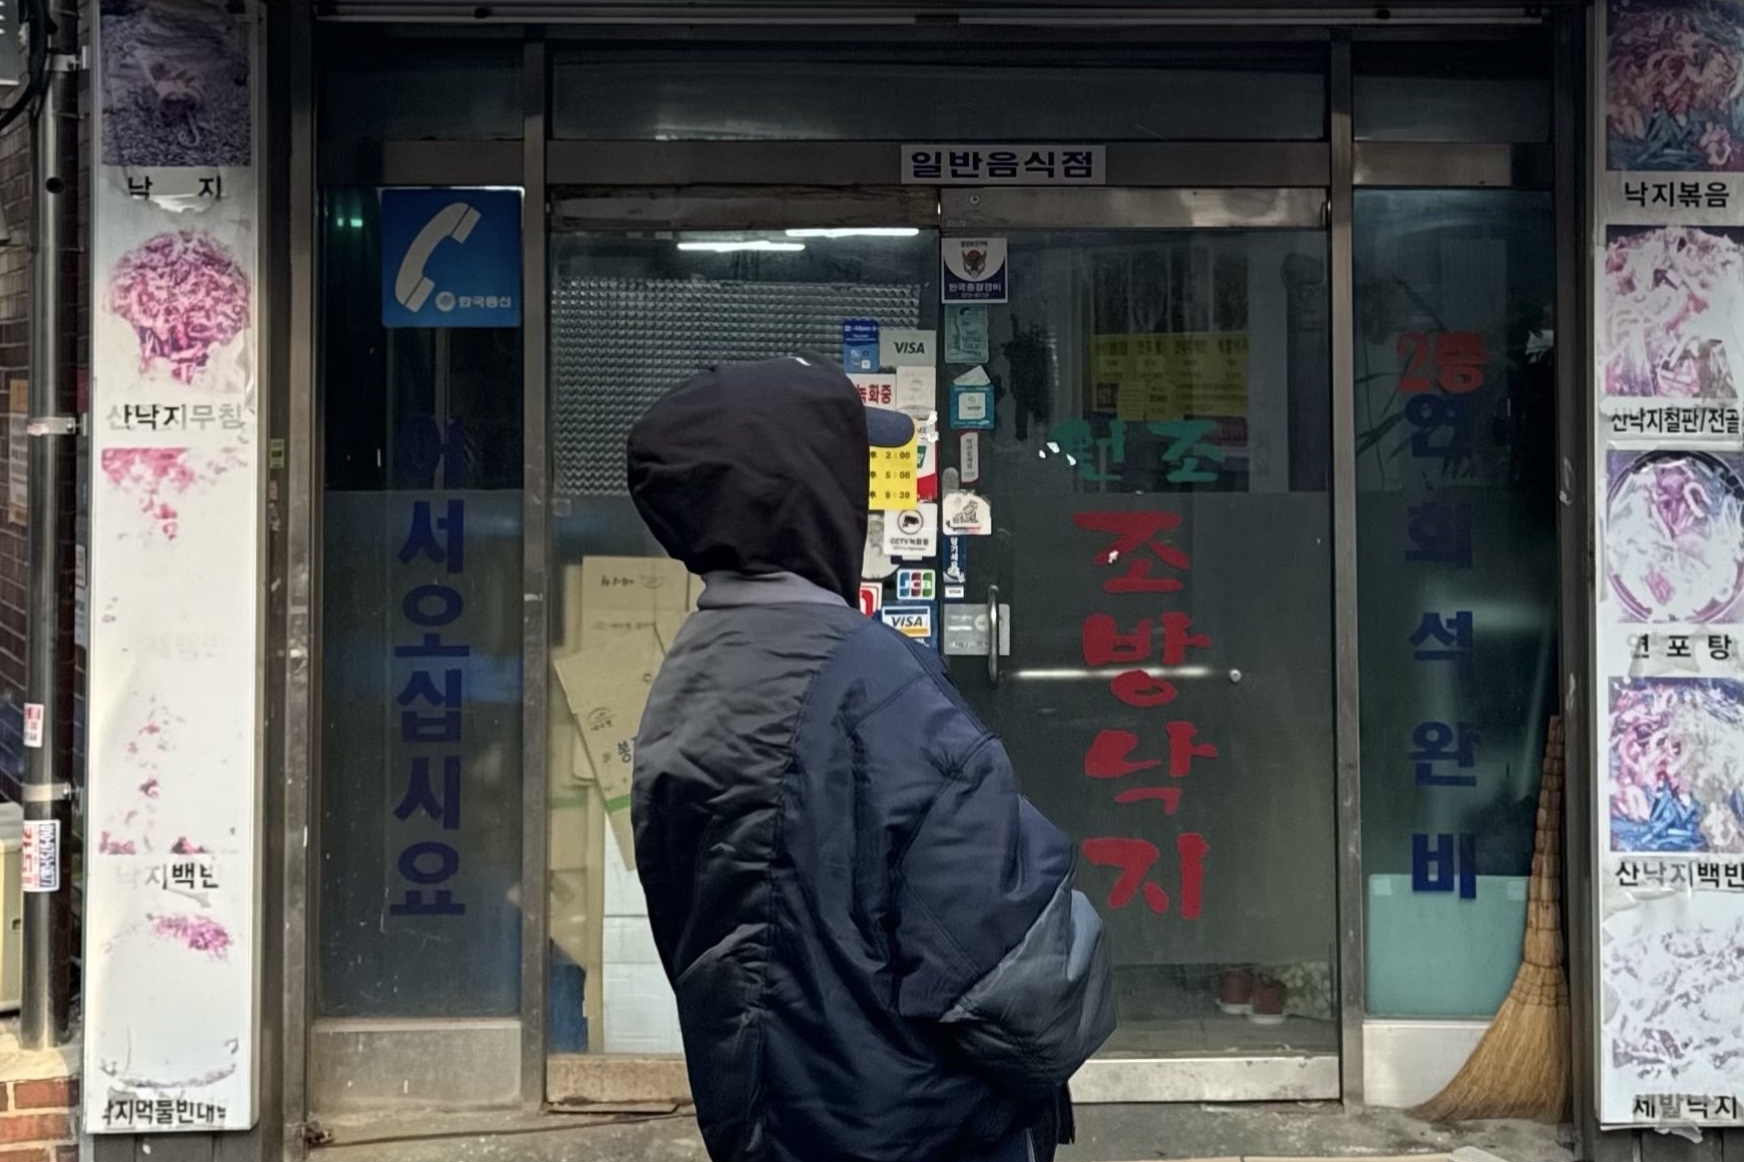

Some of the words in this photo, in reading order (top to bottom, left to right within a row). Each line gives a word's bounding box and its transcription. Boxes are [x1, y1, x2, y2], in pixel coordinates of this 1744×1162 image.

[910, 150, 1093, 179] 일반음식점
[1624, 181, 1731, 209] 낙지볶음
[893, 341, 925, 355] VISA
[107, 403, 248, 431] 산낙지무침
[1610, 406, 1740, 434] 산낙지철판/전골
[891, 615, 923, 627] VISA
[1071, 510, 1219, 921] 조방낙지
